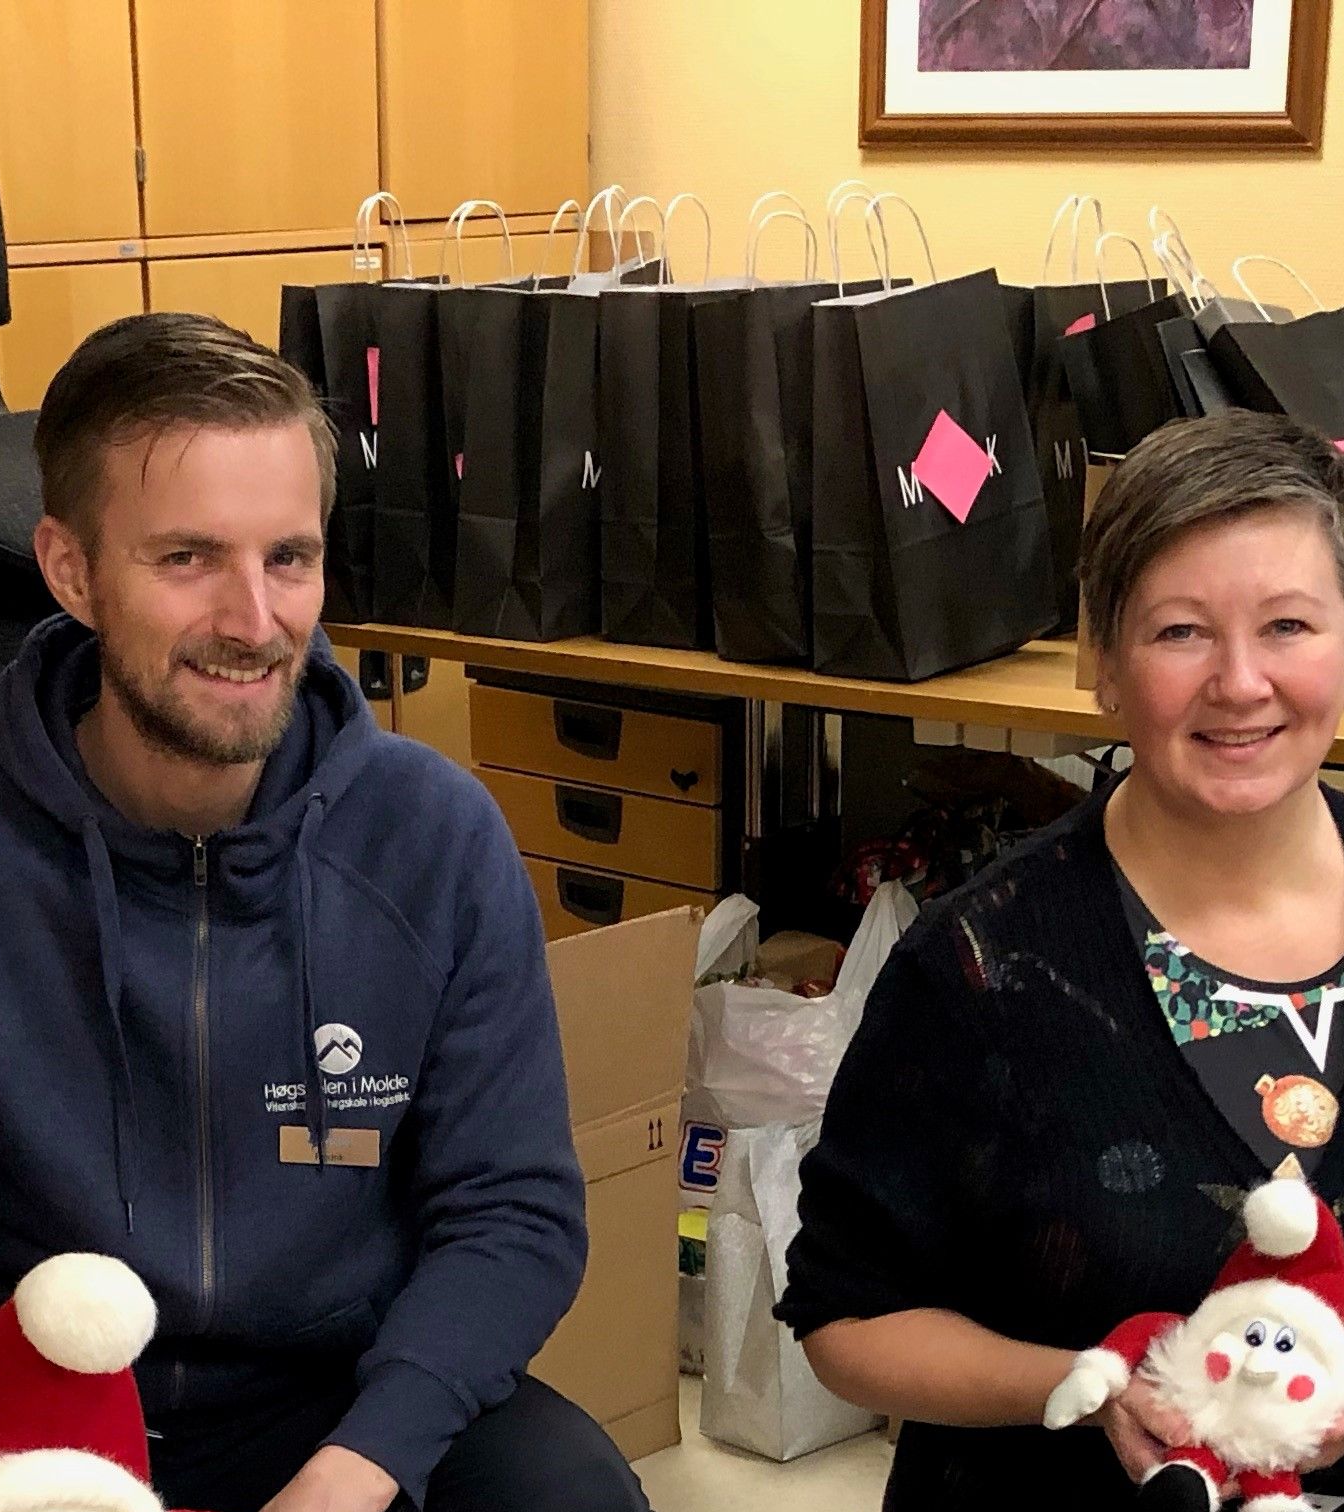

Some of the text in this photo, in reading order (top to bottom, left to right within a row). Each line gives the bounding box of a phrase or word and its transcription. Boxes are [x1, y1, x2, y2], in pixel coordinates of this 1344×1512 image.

[264, 1073, 409, 1100] Høgslen i Molde
